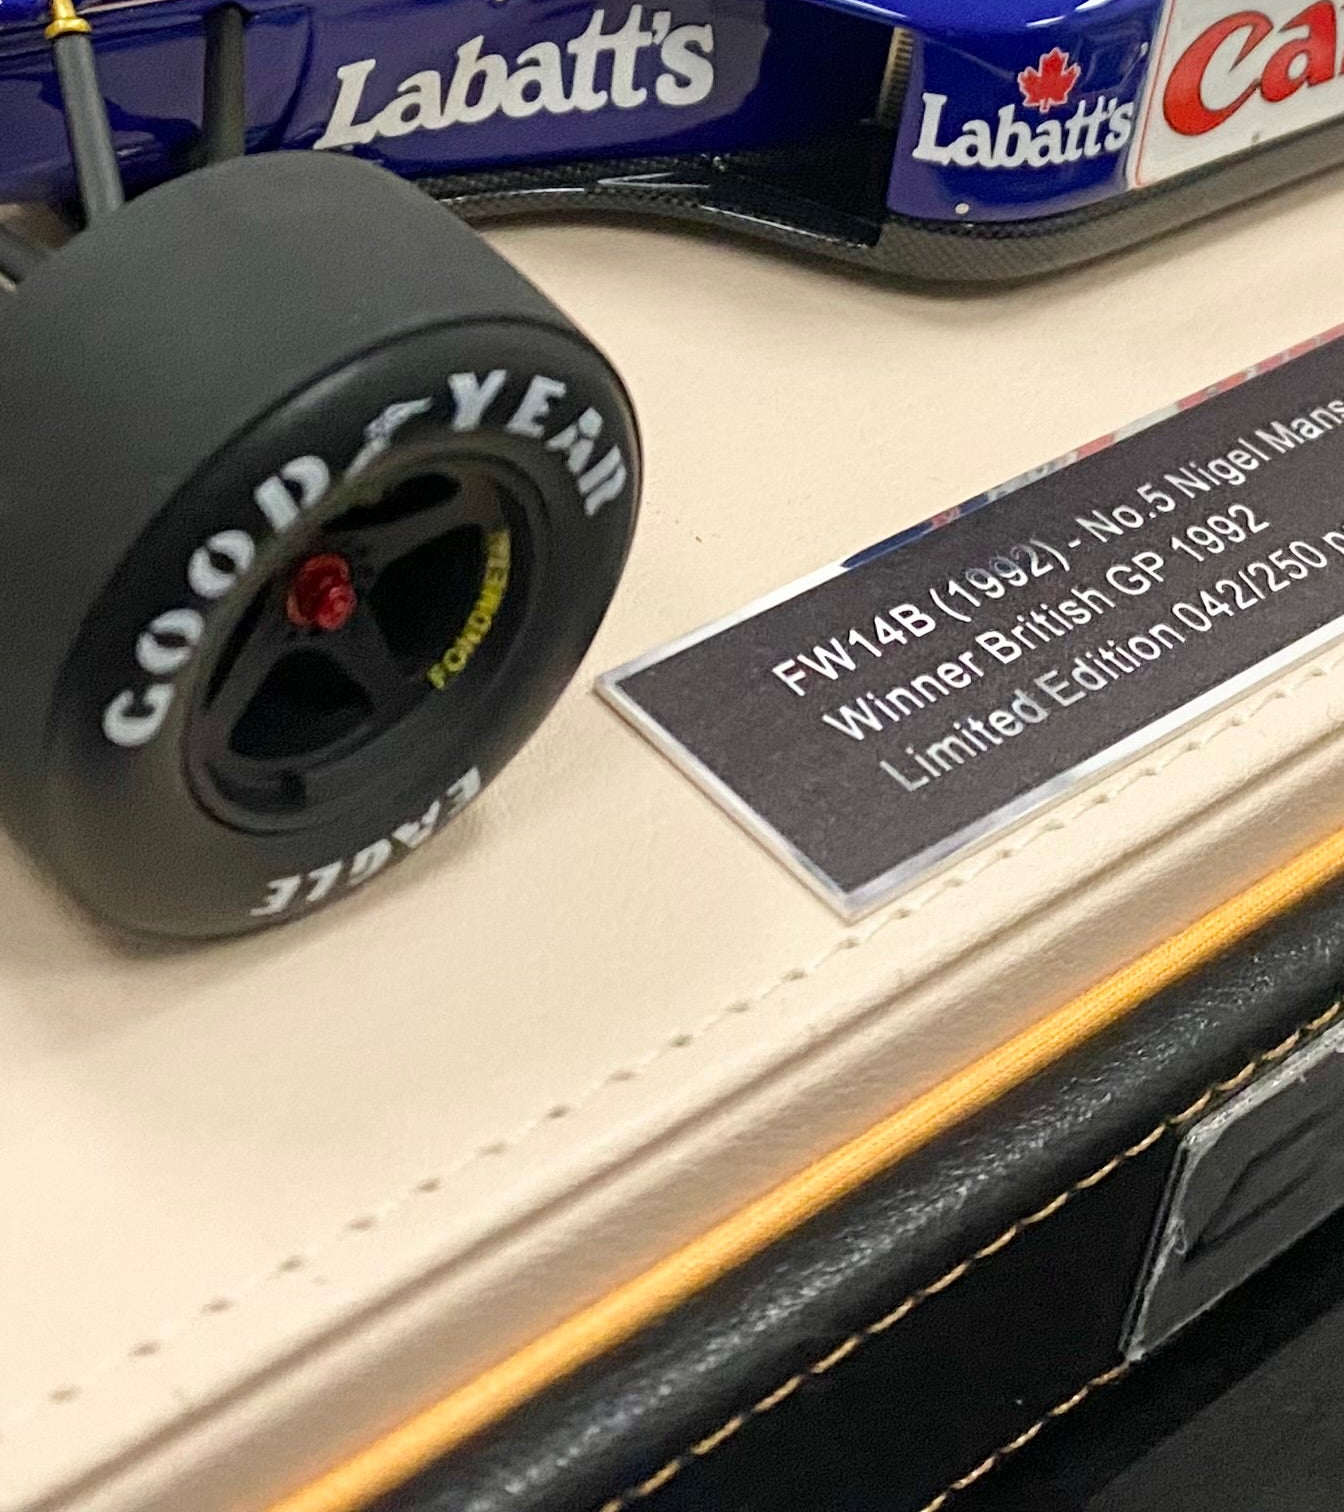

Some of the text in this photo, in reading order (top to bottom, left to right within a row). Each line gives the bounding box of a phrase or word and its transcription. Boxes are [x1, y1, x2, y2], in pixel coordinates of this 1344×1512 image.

[313, 4, 714, 149] Labatt's
[912, 91, 1134, 168] Labatt's
[104, 369, 626, 746] GOOD YEAR
[772, 601, 936, 697] FW14B
[936, 536, 1070, 623] (1992)
[1076, 483, 1177, 547] No.5
[1165, 430, 1270, 499] Nigel
[822, 502, 1271, 743] Winner British GP 1992
[880, 693, 1049, 793] Limited
[1035, 622, 1186, 707] Edition
[1174, 540, 1331, 635] 042/250
[250, 765, 482, 917] EAGLE
